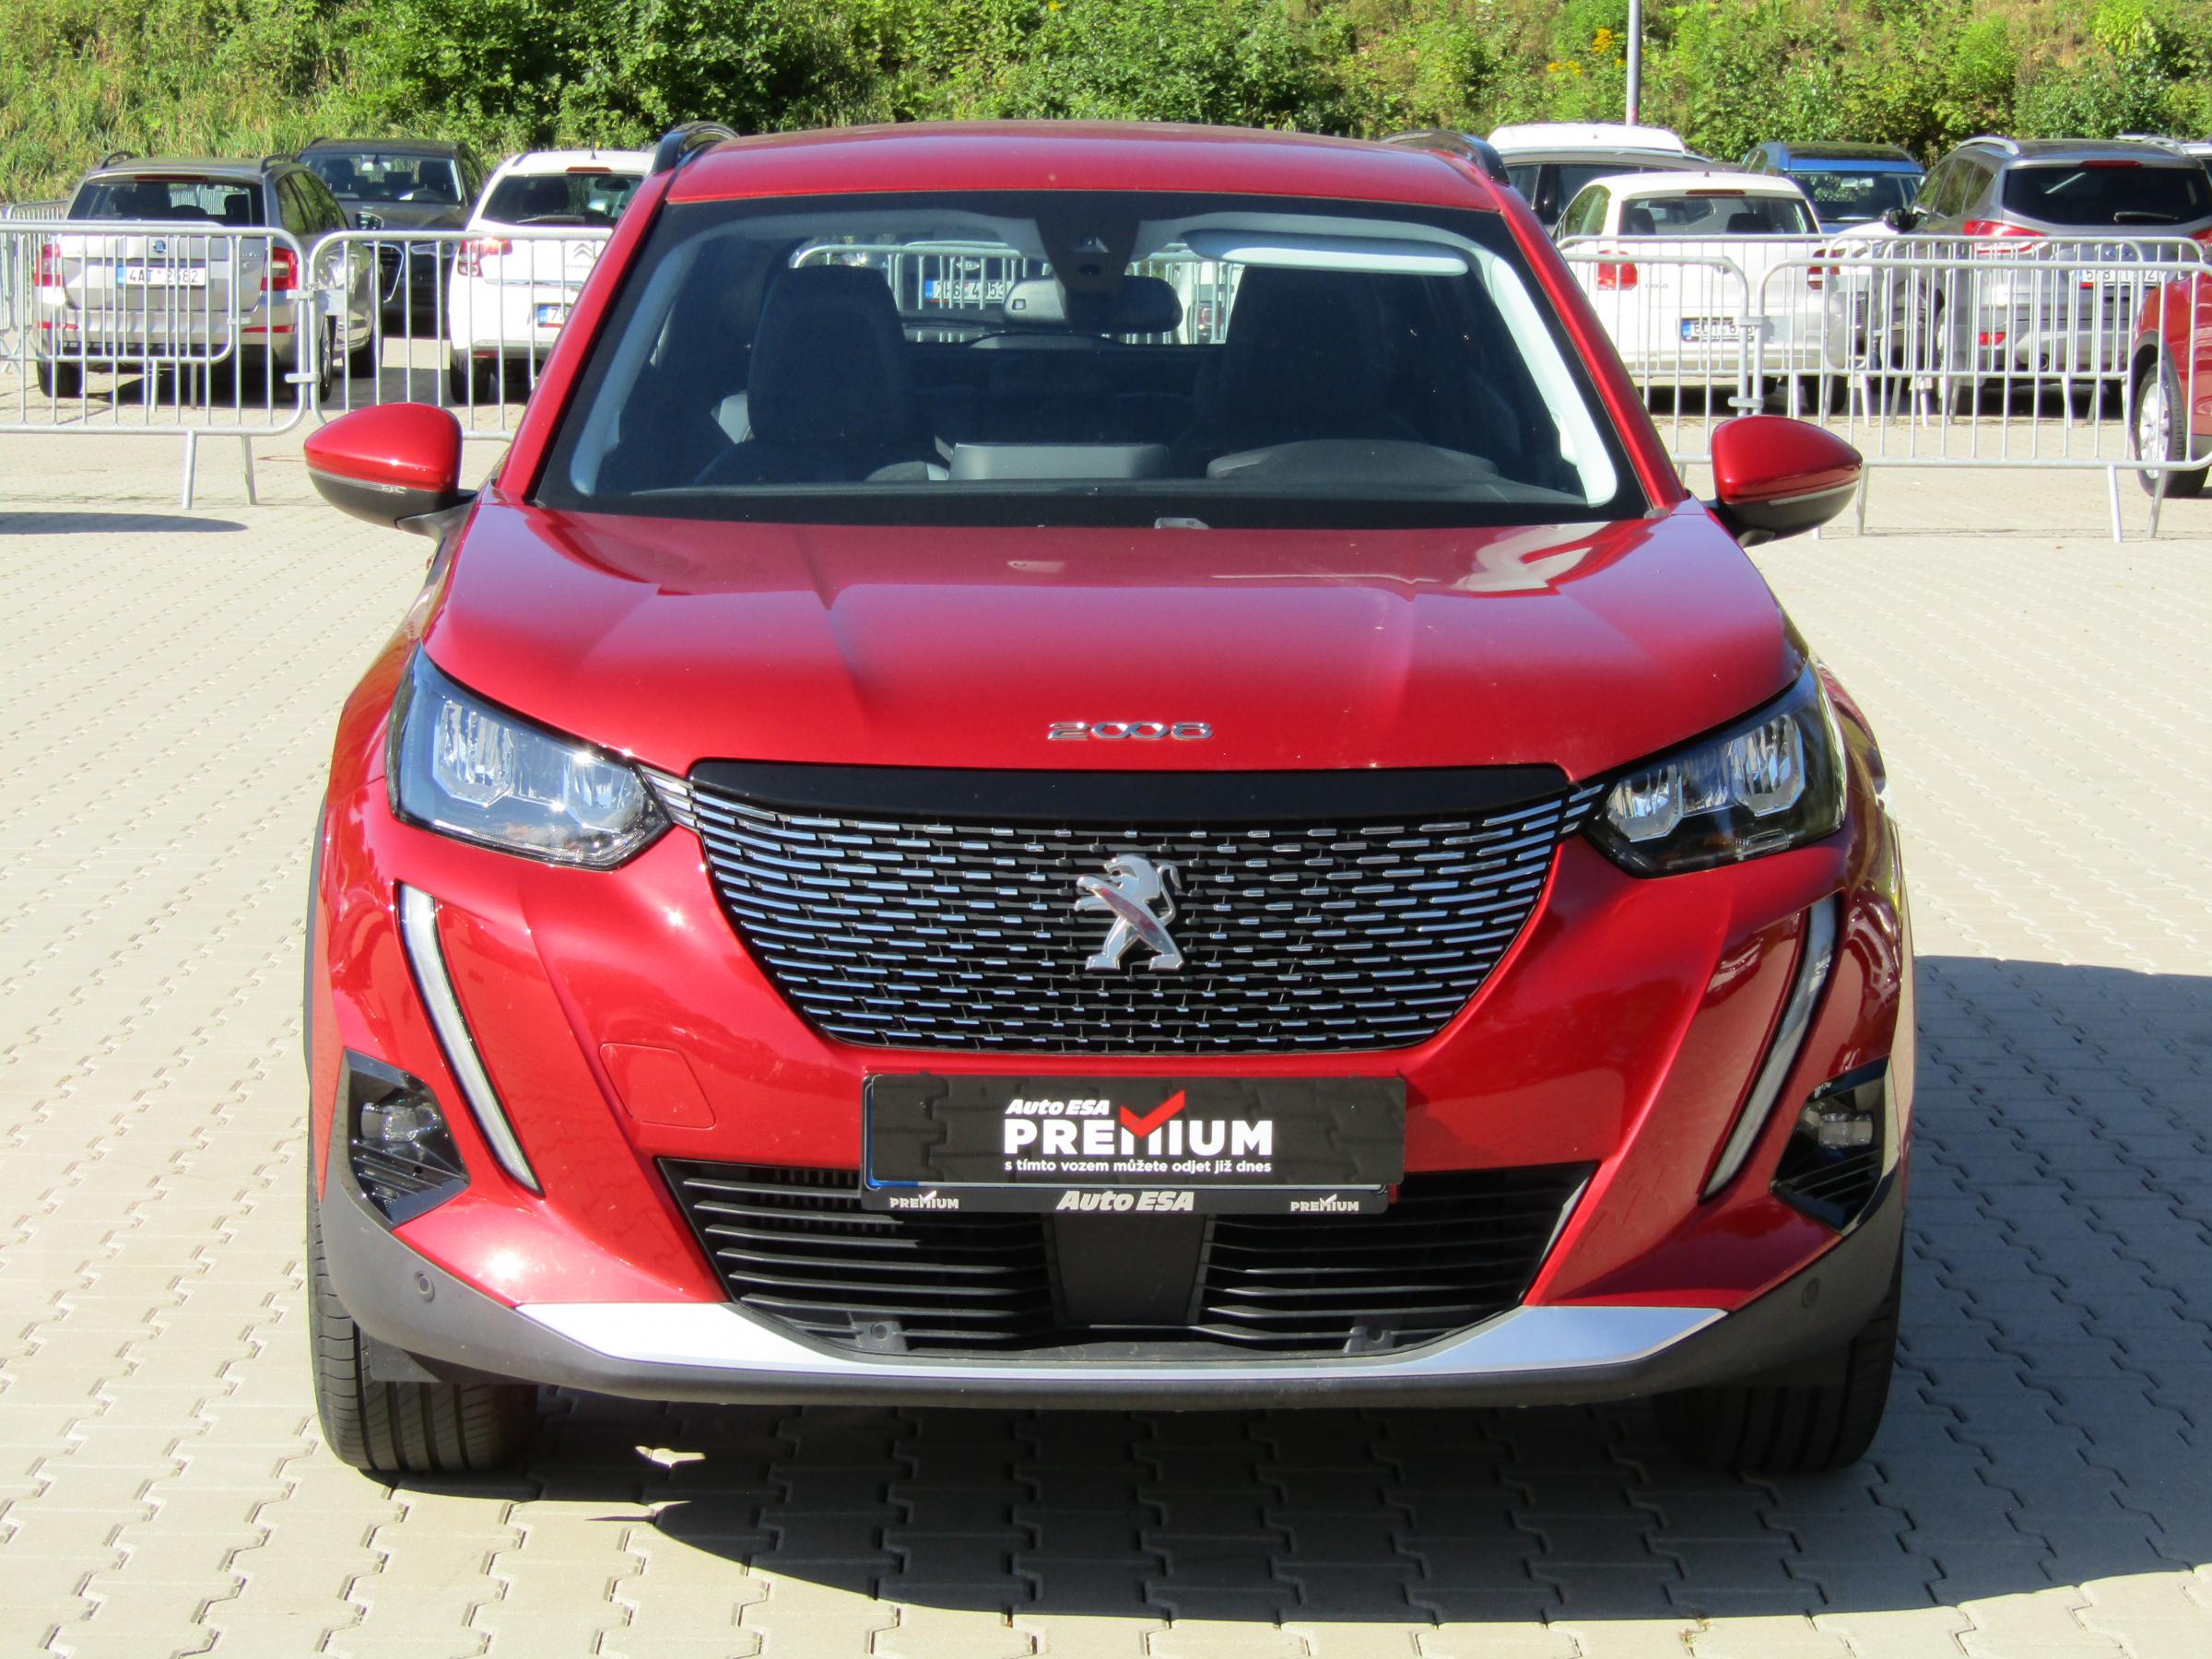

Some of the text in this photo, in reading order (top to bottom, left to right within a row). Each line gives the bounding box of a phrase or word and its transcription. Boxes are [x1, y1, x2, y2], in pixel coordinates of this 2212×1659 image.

[1047, 721, 1214, 741] 2008
[1005, 1099, 1110, 1115] Auto ESA
[1004, 1118, 1273, 1157] PREMIUM
[1005, 1159, 1272, 1174] s tímto vozem můžete odjet již dnes
[889, 1196, 959, 1209] PREMIUM
[1055, 1191, 1195, 1212] Auto ESA
[1290, 1200, 1359, 1212] PREMIUM
